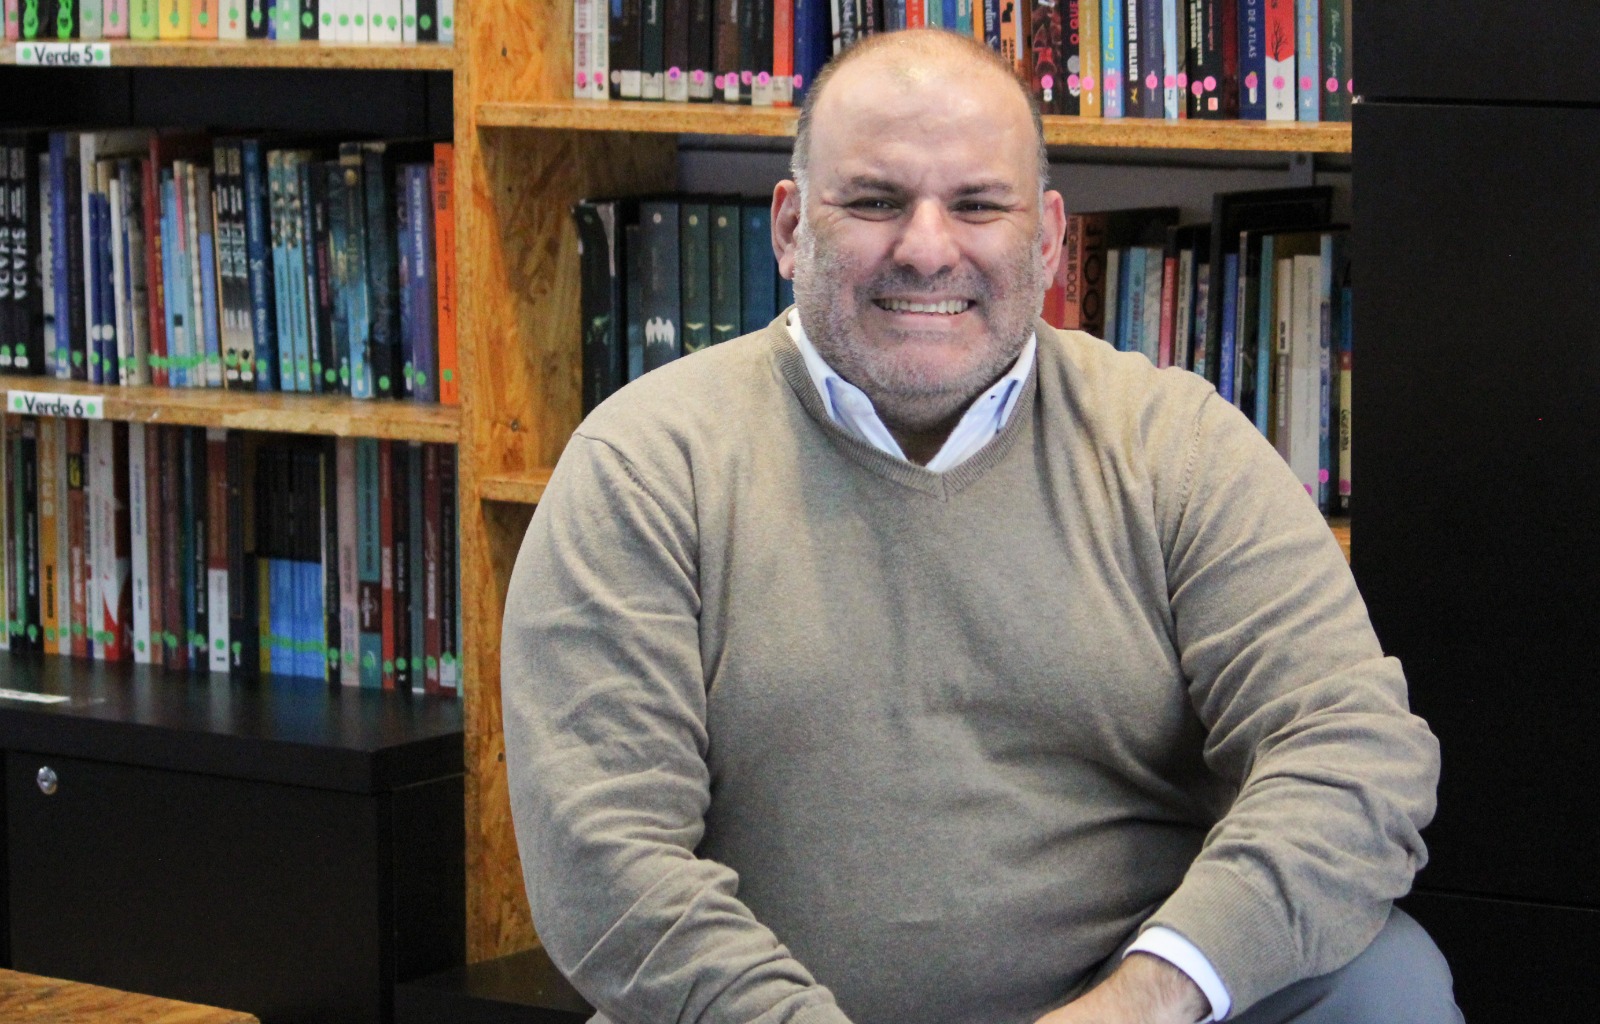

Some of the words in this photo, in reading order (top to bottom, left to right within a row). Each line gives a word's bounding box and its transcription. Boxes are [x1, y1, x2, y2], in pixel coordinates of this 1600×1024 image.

[1247, 9, 1257, 22] DE
[34, 44, 80, 64] Verde
[83, 45, 93, 64] 5
[1248, 25, 1258, 59] ATLAS
[1128, 43, 1138, 82] HILLIER
[1067, 217, 1079, 262] VIRGINIA
[12, 228, 27, 300] SHADA
[1066, 263, 1078, 303] WOOLF
[24, 395, 70, 416] Verde
[73, 399, 84, 416] 6
